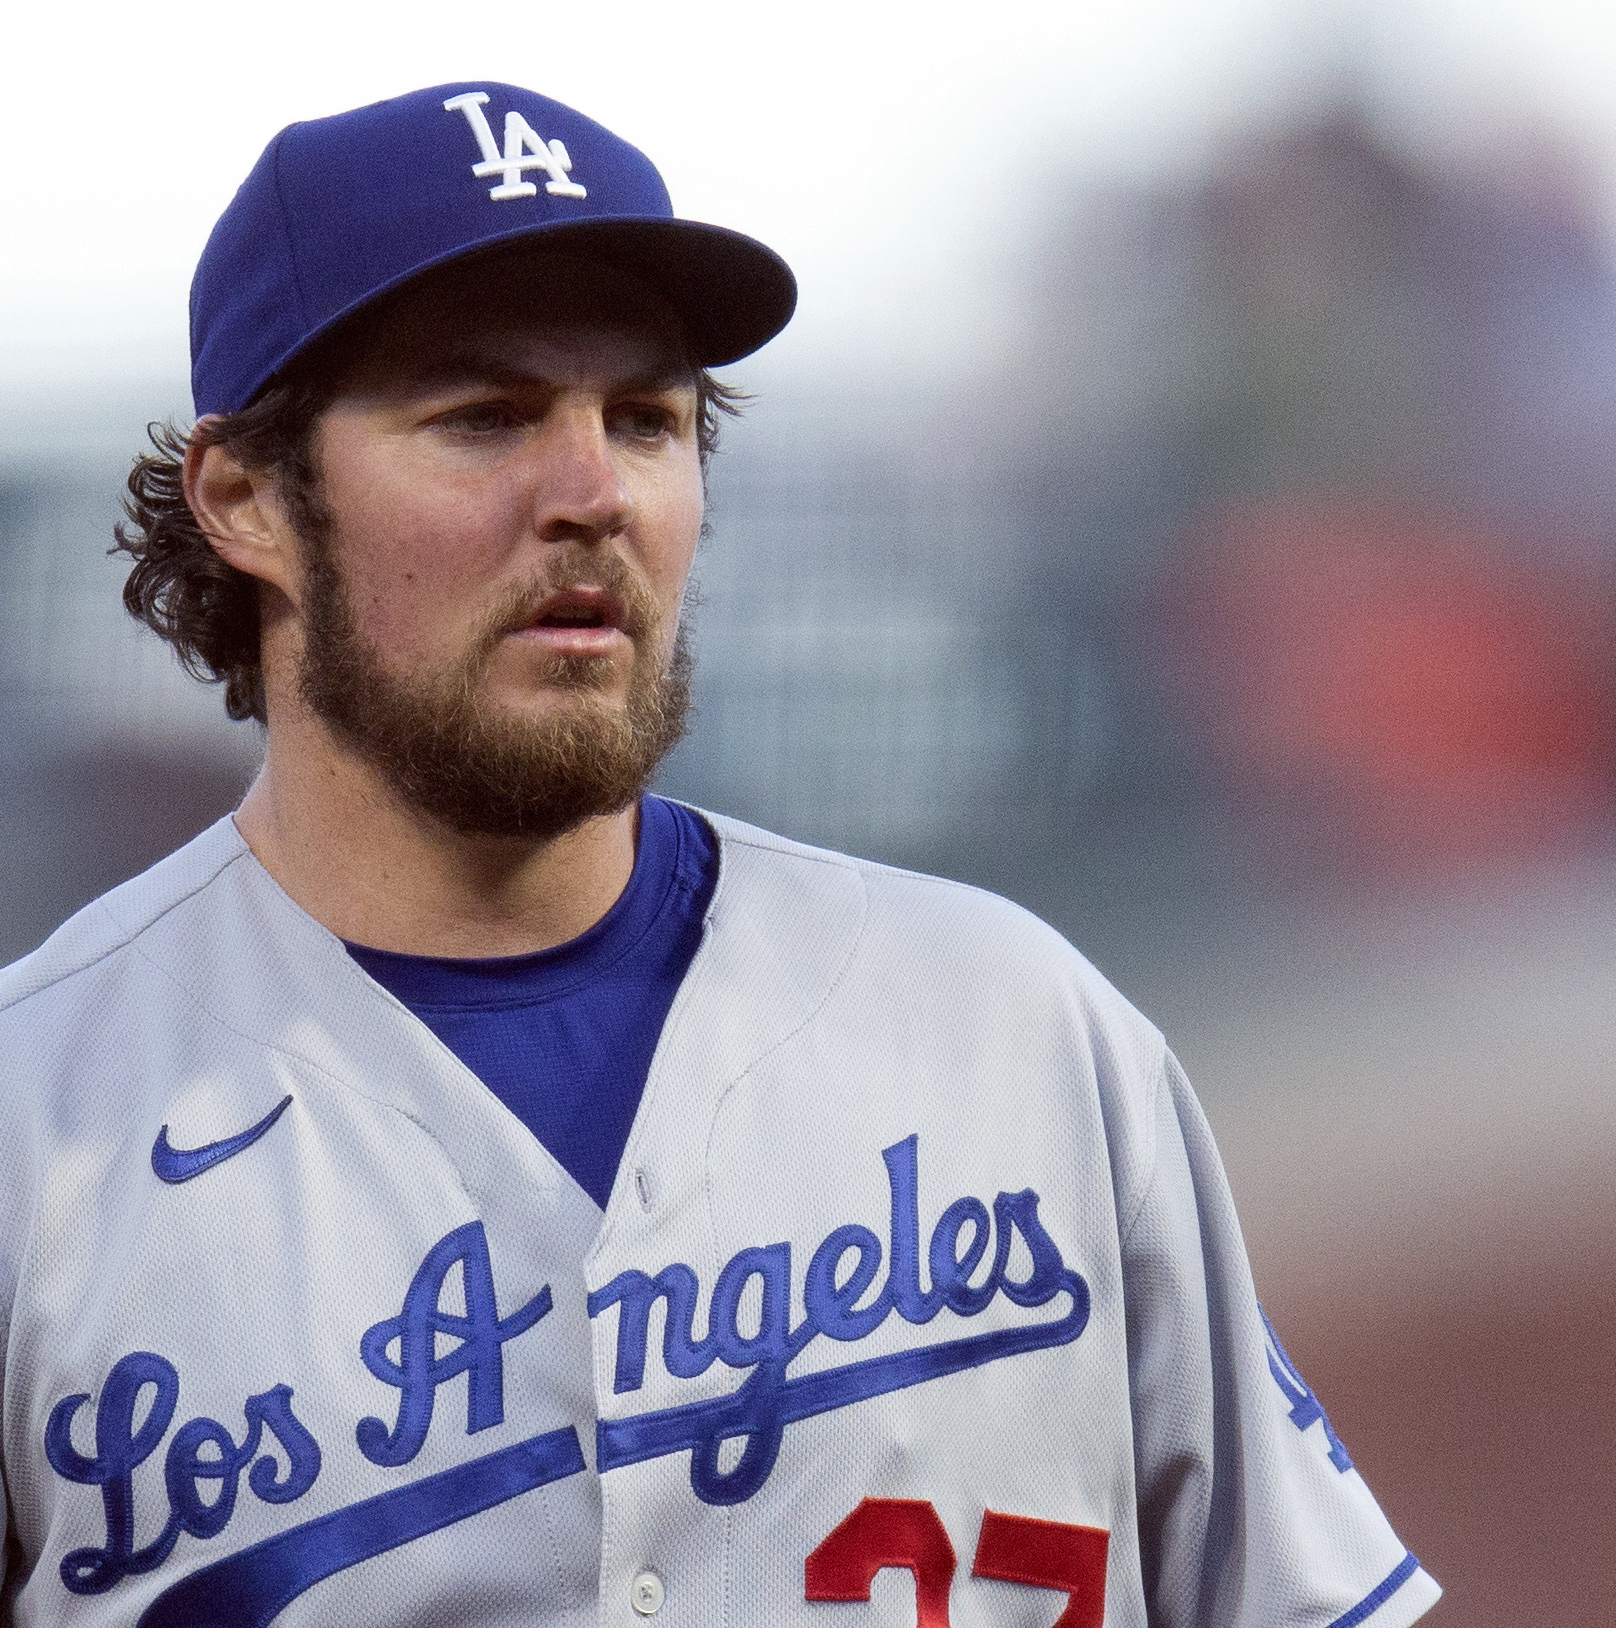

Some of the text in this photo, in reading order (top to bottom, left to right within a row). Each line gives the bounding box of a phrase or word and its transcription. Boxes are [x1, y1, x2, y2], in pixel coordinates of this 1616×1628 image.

[442, 91, 587, 201] LA
[44, 1351, 322, 1595] Los
[355, 1133, 1091, 1507] Angeles
